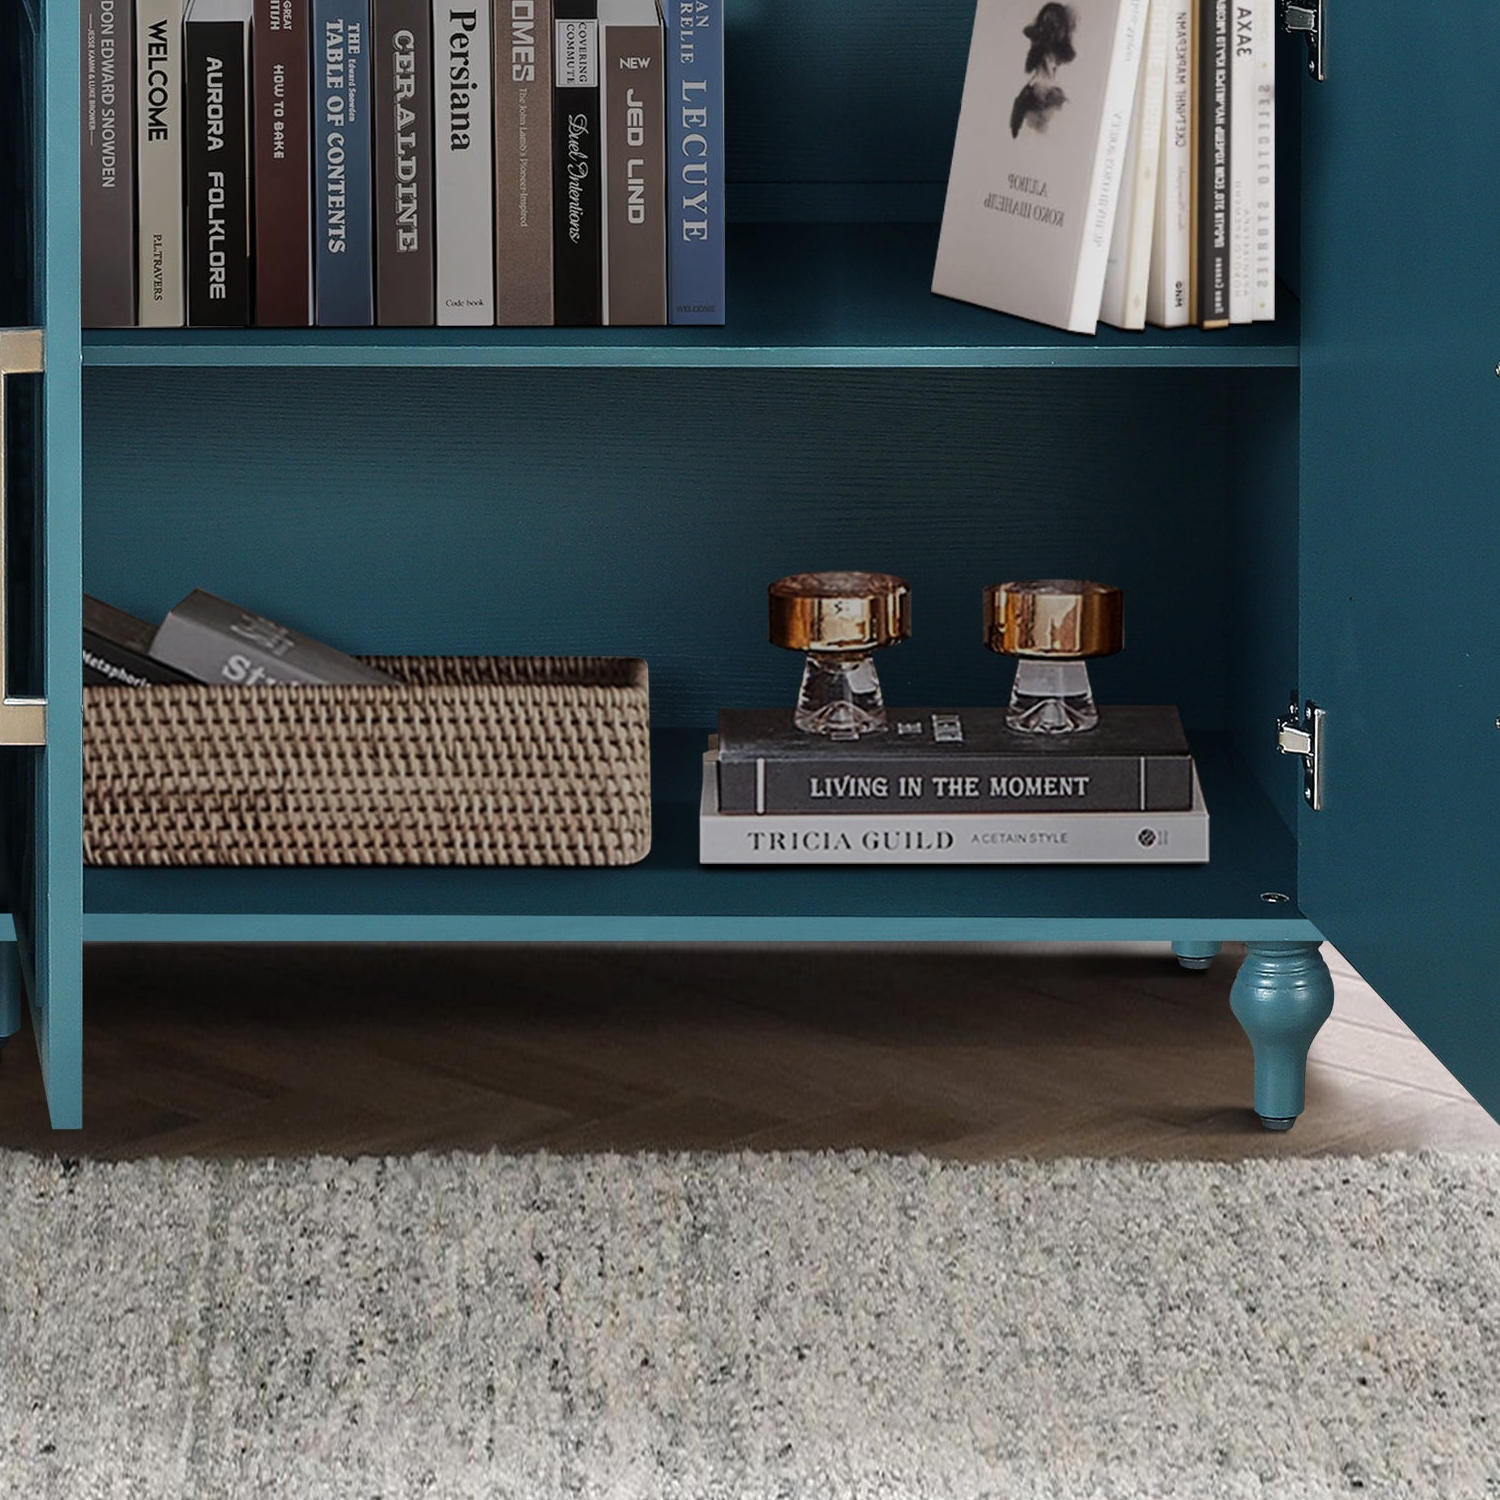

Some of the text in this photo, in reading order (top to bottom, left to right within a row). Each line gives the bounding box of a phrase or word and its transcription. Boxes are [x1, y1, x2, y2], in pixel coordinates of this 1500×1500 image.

[283, 0, 292, 31] GREAT
[347, 23, 360, 55] THE
[100, 38, 115, 106] EDWARD
[148, 19, 168, 142] WELCOME
[449, 8, 478, 152] Persiana
[566, 23, 576, 84] COMMUTE
[578, 21, 588, 83] COVERING
[619, 57, 651, 69] NEW
[273, 64, 285, 160] HOW TO BAKE
[519, 88, 528, 103] The
[519, 105, 528, 125] John
[101, 108, 116, 188] SNOWDEN
[325, 18, 346, 254] TABLE OF CONTENTS
[568, 113, 589, 161] Duel
[626, 88, 645, 224] JED LIND
[681, 79, 708, 242] LECUYE
[206, 56, 226, 300] AURORA FOLKLORE
[809, 774, 1090, 799] LIVING IN THE MOMENT
[747, 831, 955, 852] TRICIA GUILD
[1029, 832, 1069, 844] STYLE
